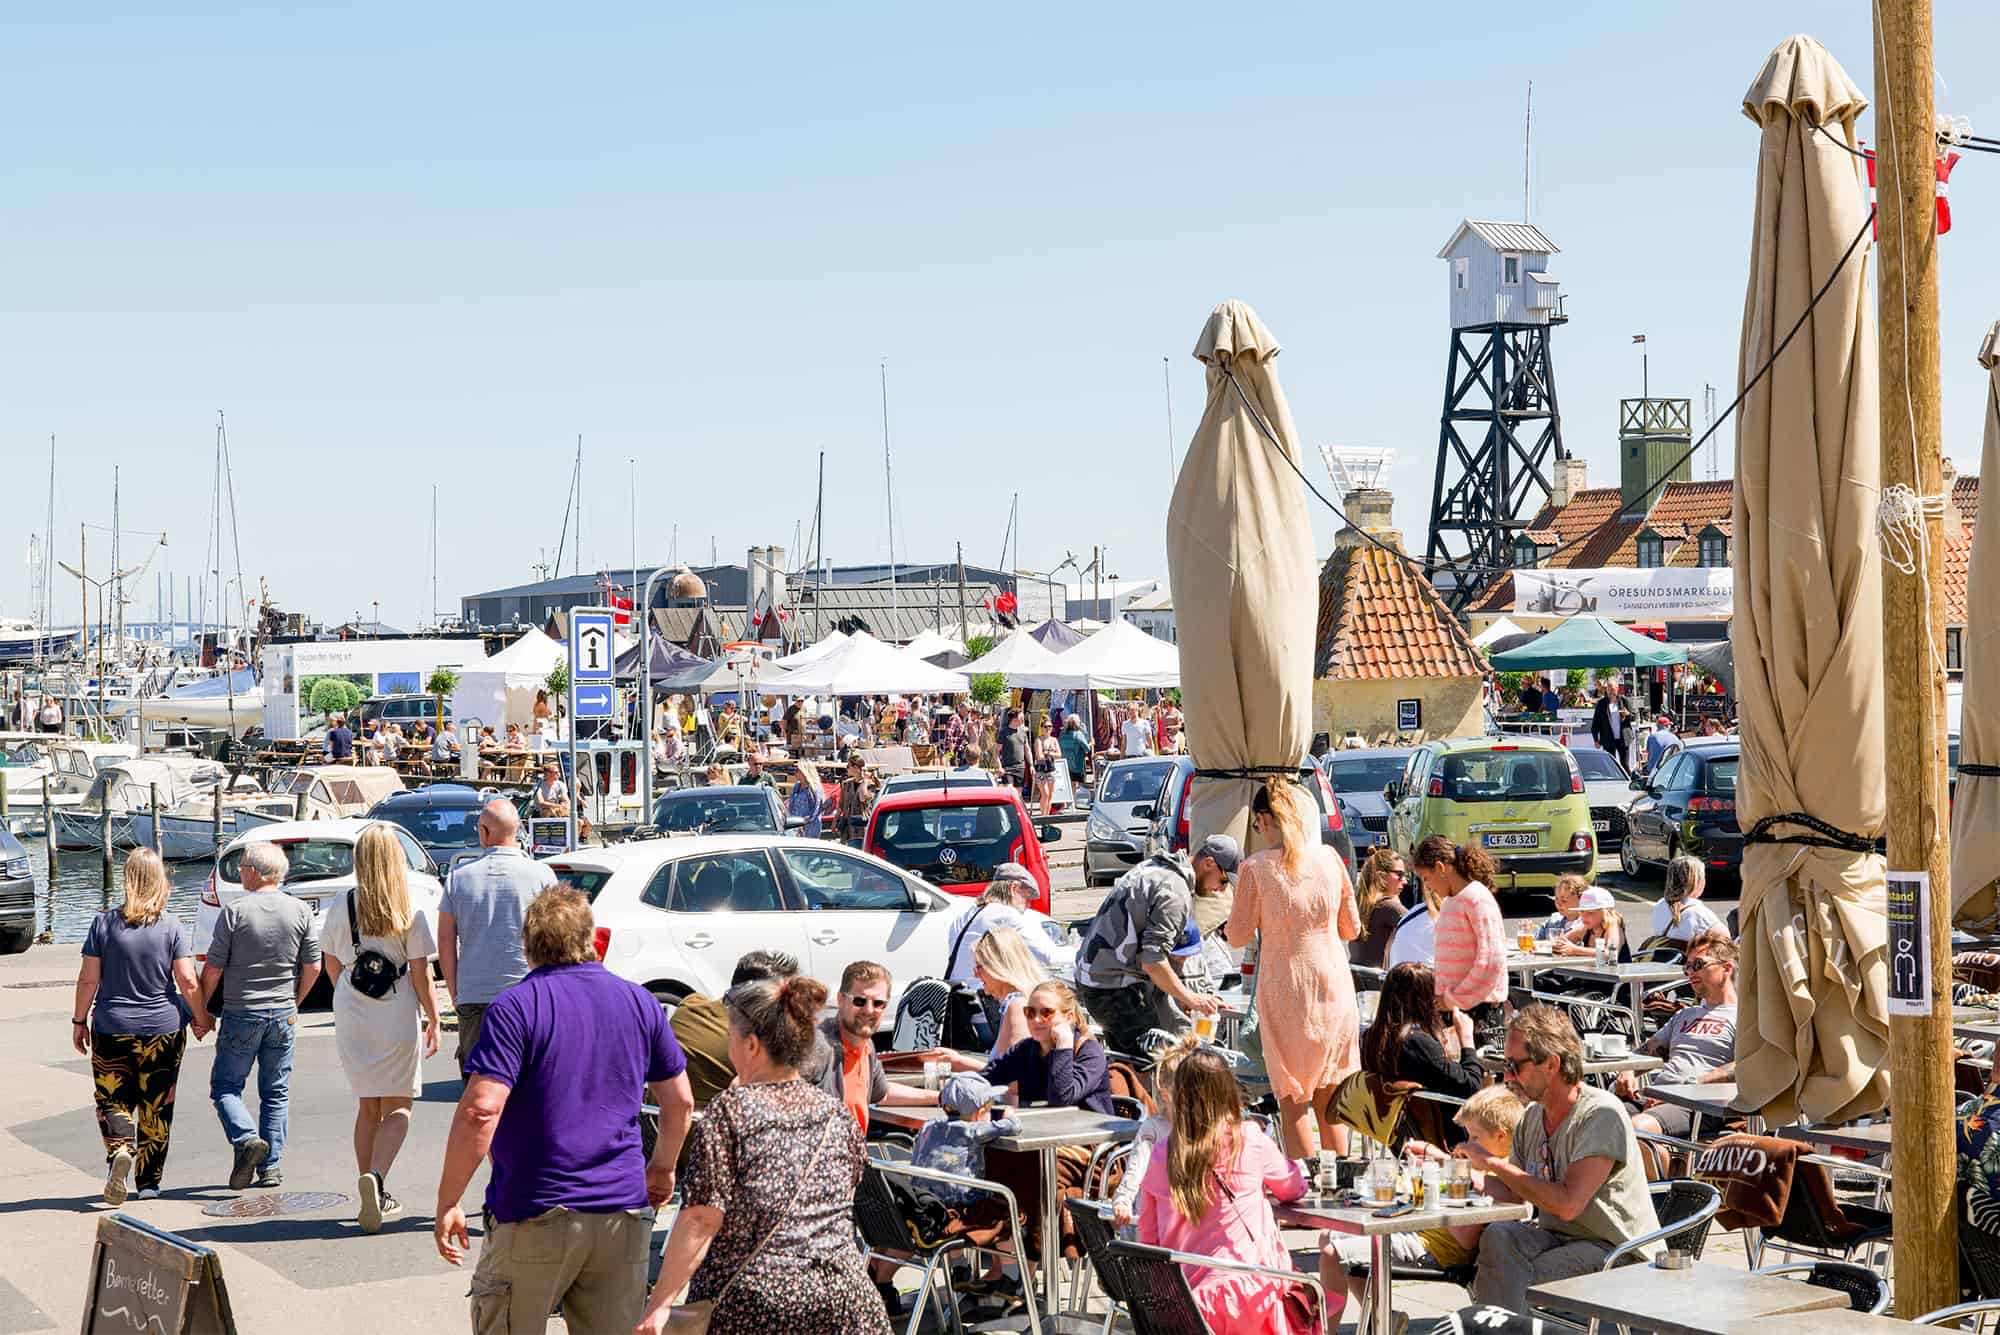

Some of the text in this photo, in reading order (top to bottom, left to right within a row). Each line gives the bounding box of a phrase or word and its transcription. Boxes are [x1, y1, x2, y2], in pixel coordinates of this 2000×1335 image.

[1490, 834, 1536, 844] CF 48 320
[1680, 1018, 1728, 1035] VANS
